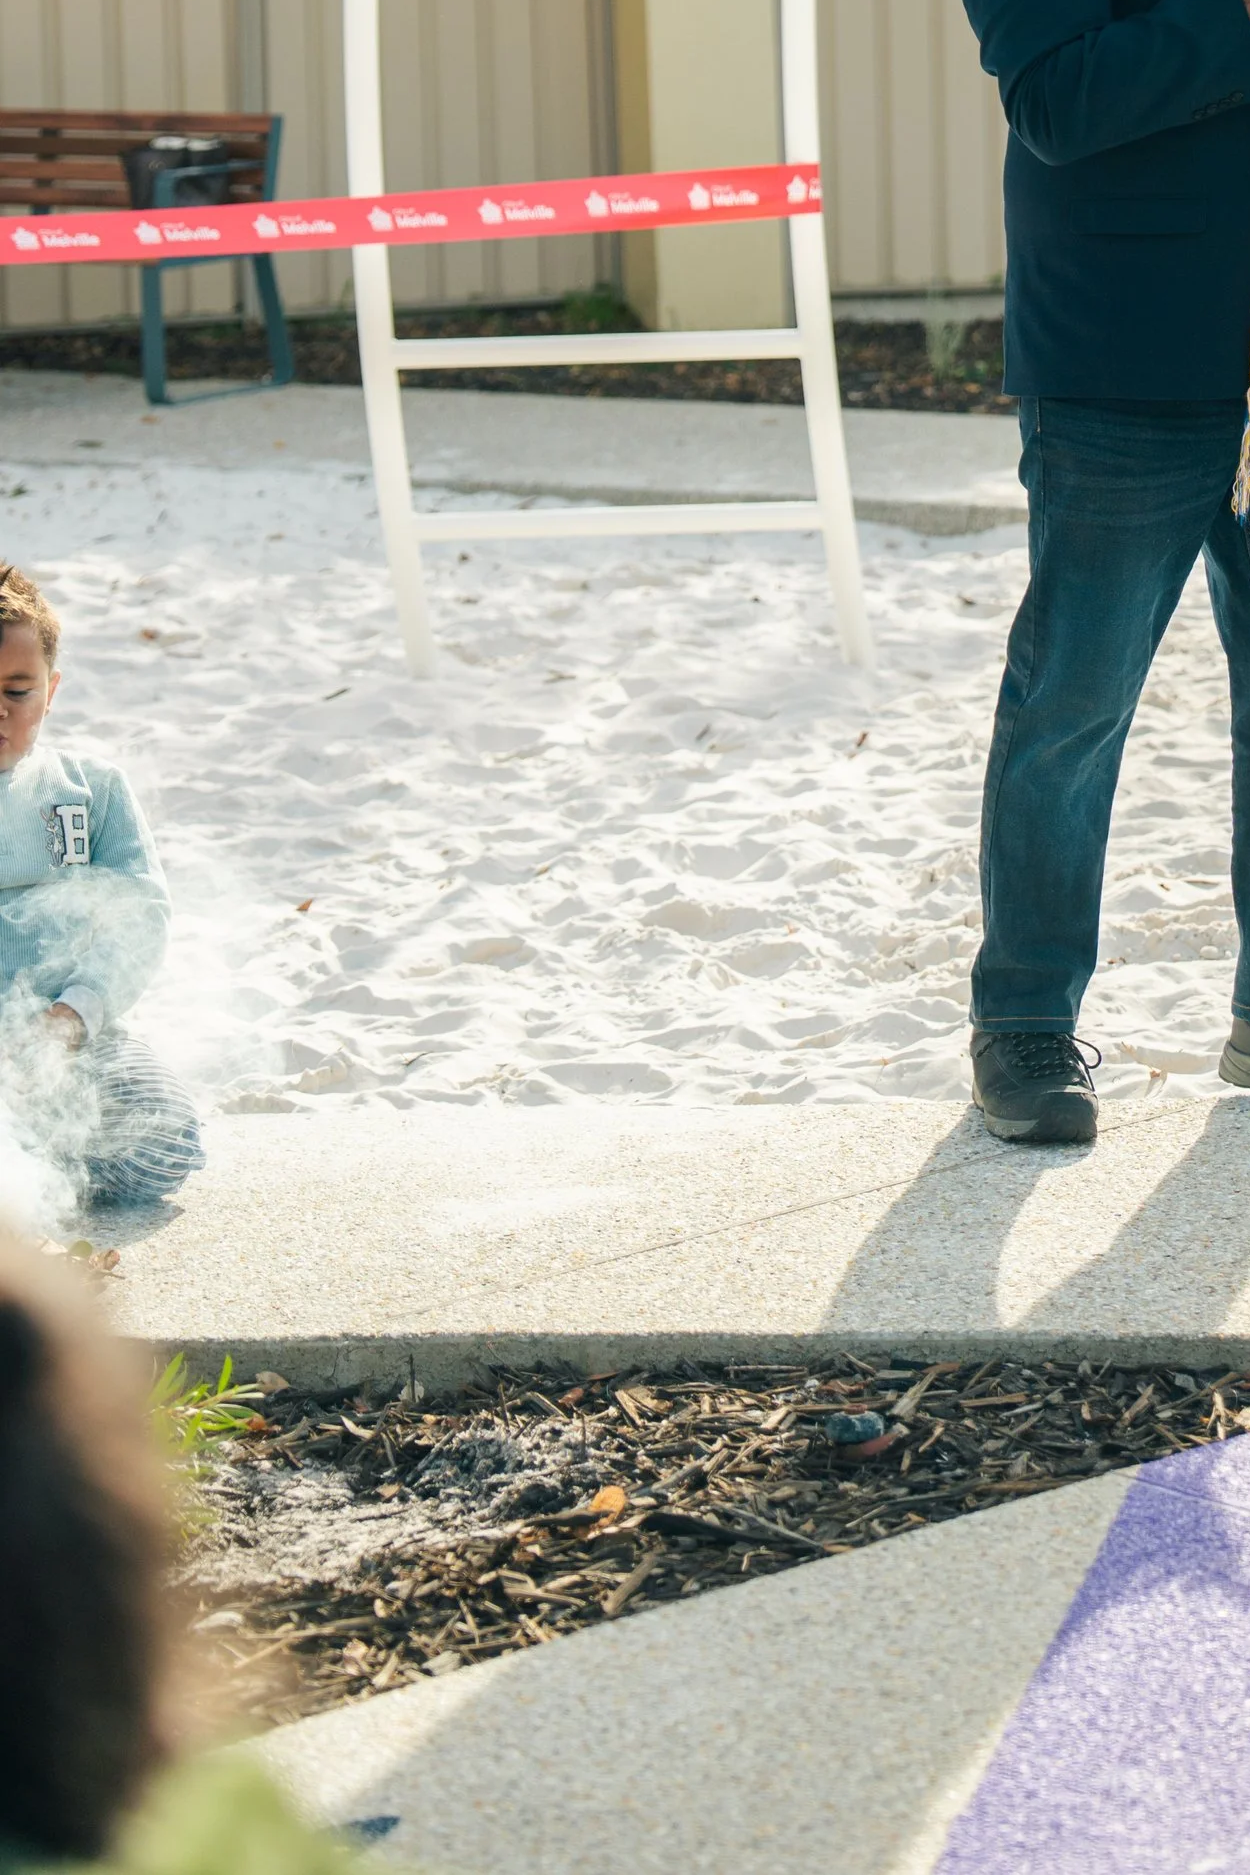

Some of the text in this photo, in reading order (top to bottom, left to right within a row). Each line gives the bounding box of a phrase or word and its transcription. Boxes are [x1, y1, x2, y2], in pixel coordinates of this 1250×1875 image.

[610, 197, 660, 214] Melville
[711, 189, 760, 206] Melville
[396, 211, 448, 228] Melville
[504, 204, 556, 221] Melville
[165, 225, 220, 241] Melville
[282, 219, 336, 234] Melville
[43, 232, 100, 247] Melville
